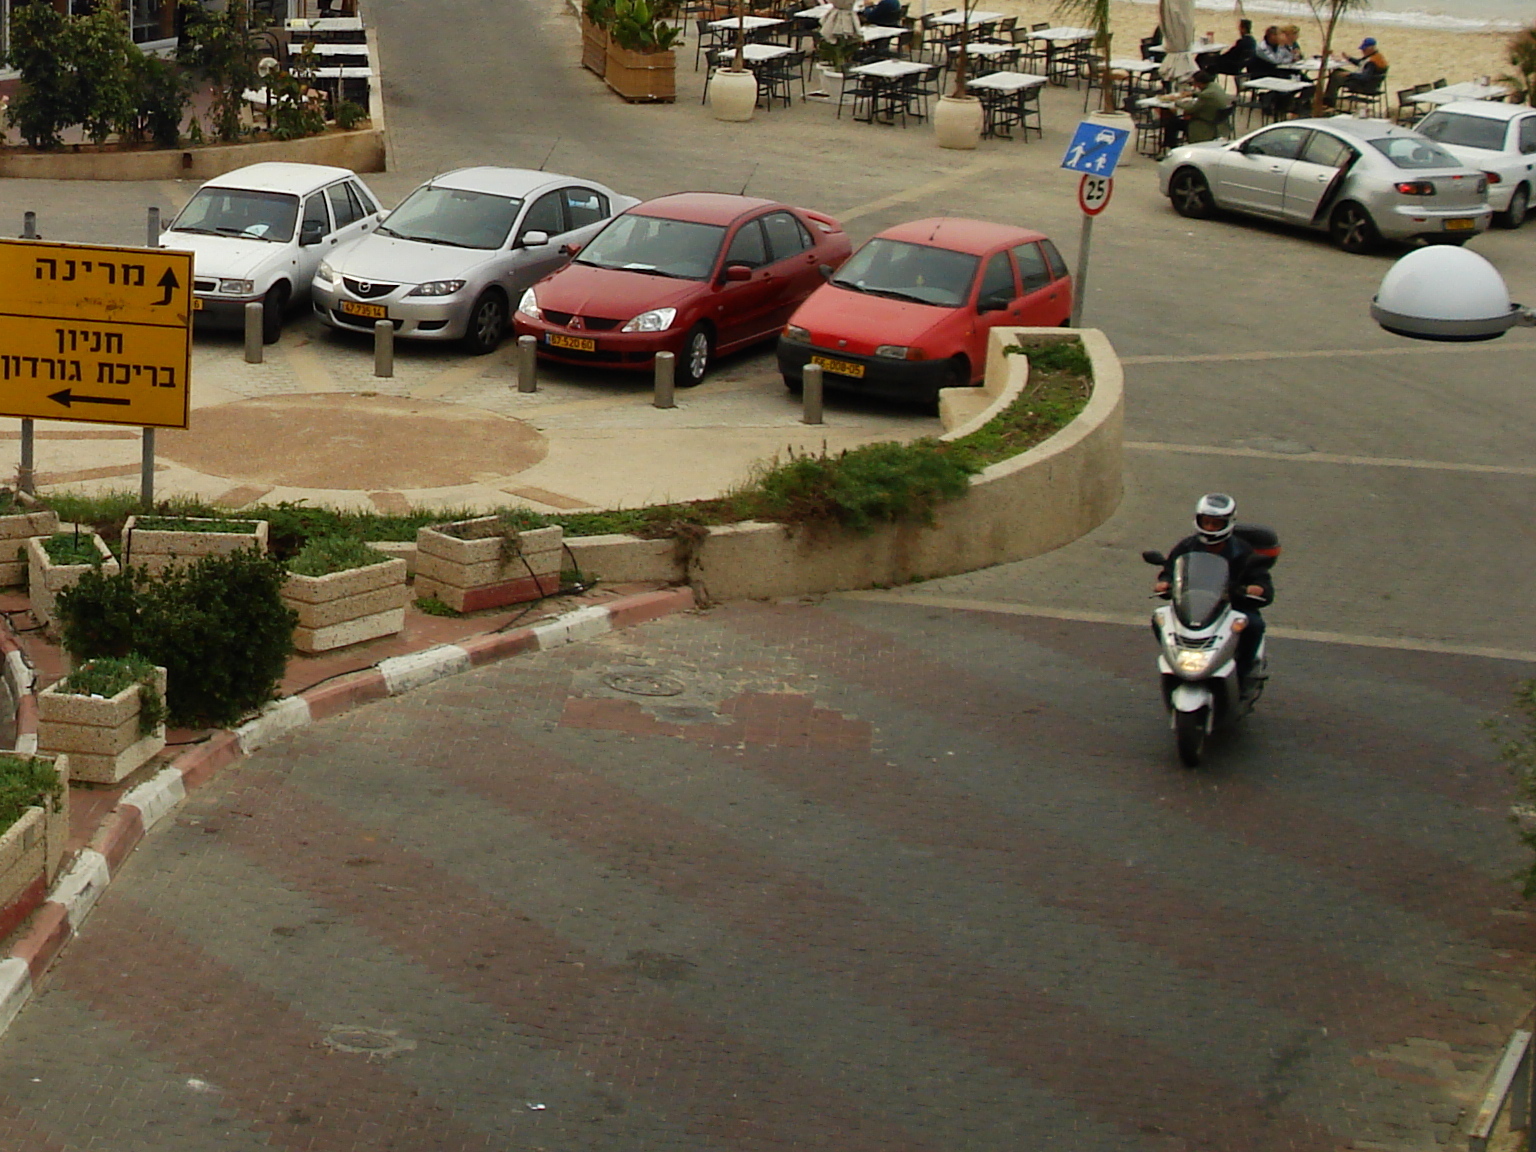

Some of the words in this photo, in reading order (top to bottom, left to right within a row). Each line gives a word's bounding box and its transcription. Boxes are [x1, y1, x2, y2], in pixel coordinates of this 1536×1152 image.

[1086, 179, 1106, 201] 25
[35, 257, 145, 287] מרינה
[55, 328, 123, 354] חניון
[0, 355, 82, 382] גורדון
[96, 361, 176, 388] בריכת
